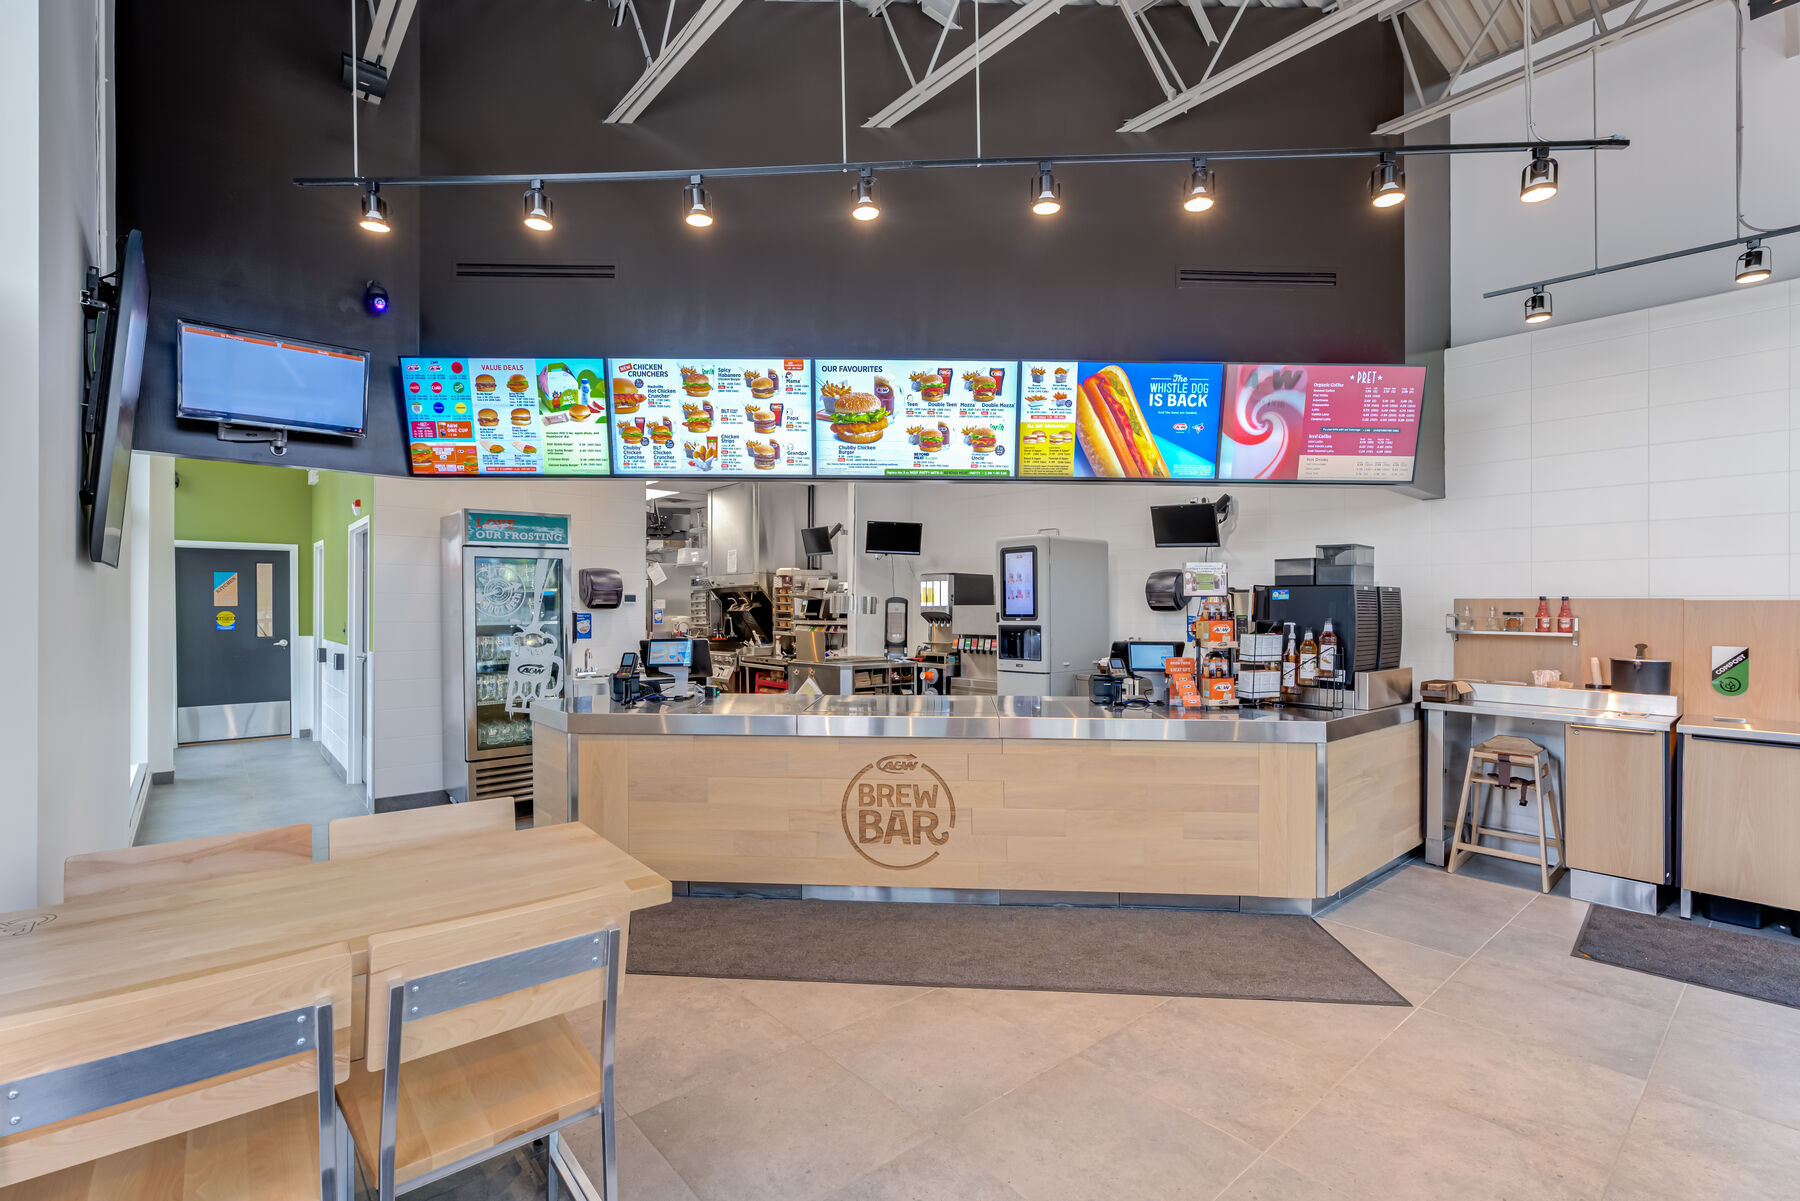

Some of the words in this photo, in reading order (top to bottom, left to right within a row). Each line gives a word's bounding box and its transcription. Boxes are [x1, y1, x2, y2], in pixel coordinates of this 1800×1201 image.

[1173, 374, 1188, 382] The
[1357, 371, 1376, 384] PRET
[1150, 383, 1188, 393] WHISTLE
[1192, 383, 1208, 393] DOG
[1149, 394, 1163, 407] IS
[1167, 394, 1208, 407] BACK
[476, 518, 516, 530] LOVE
[476, 530, 501, 539] OUR
[505, 531, 562, 541] FROSTING
[1715, 654, 1746, 675] COMPOST
[858, 783, 938, 808] BREW
[859, 810, 950, 846] BAR
